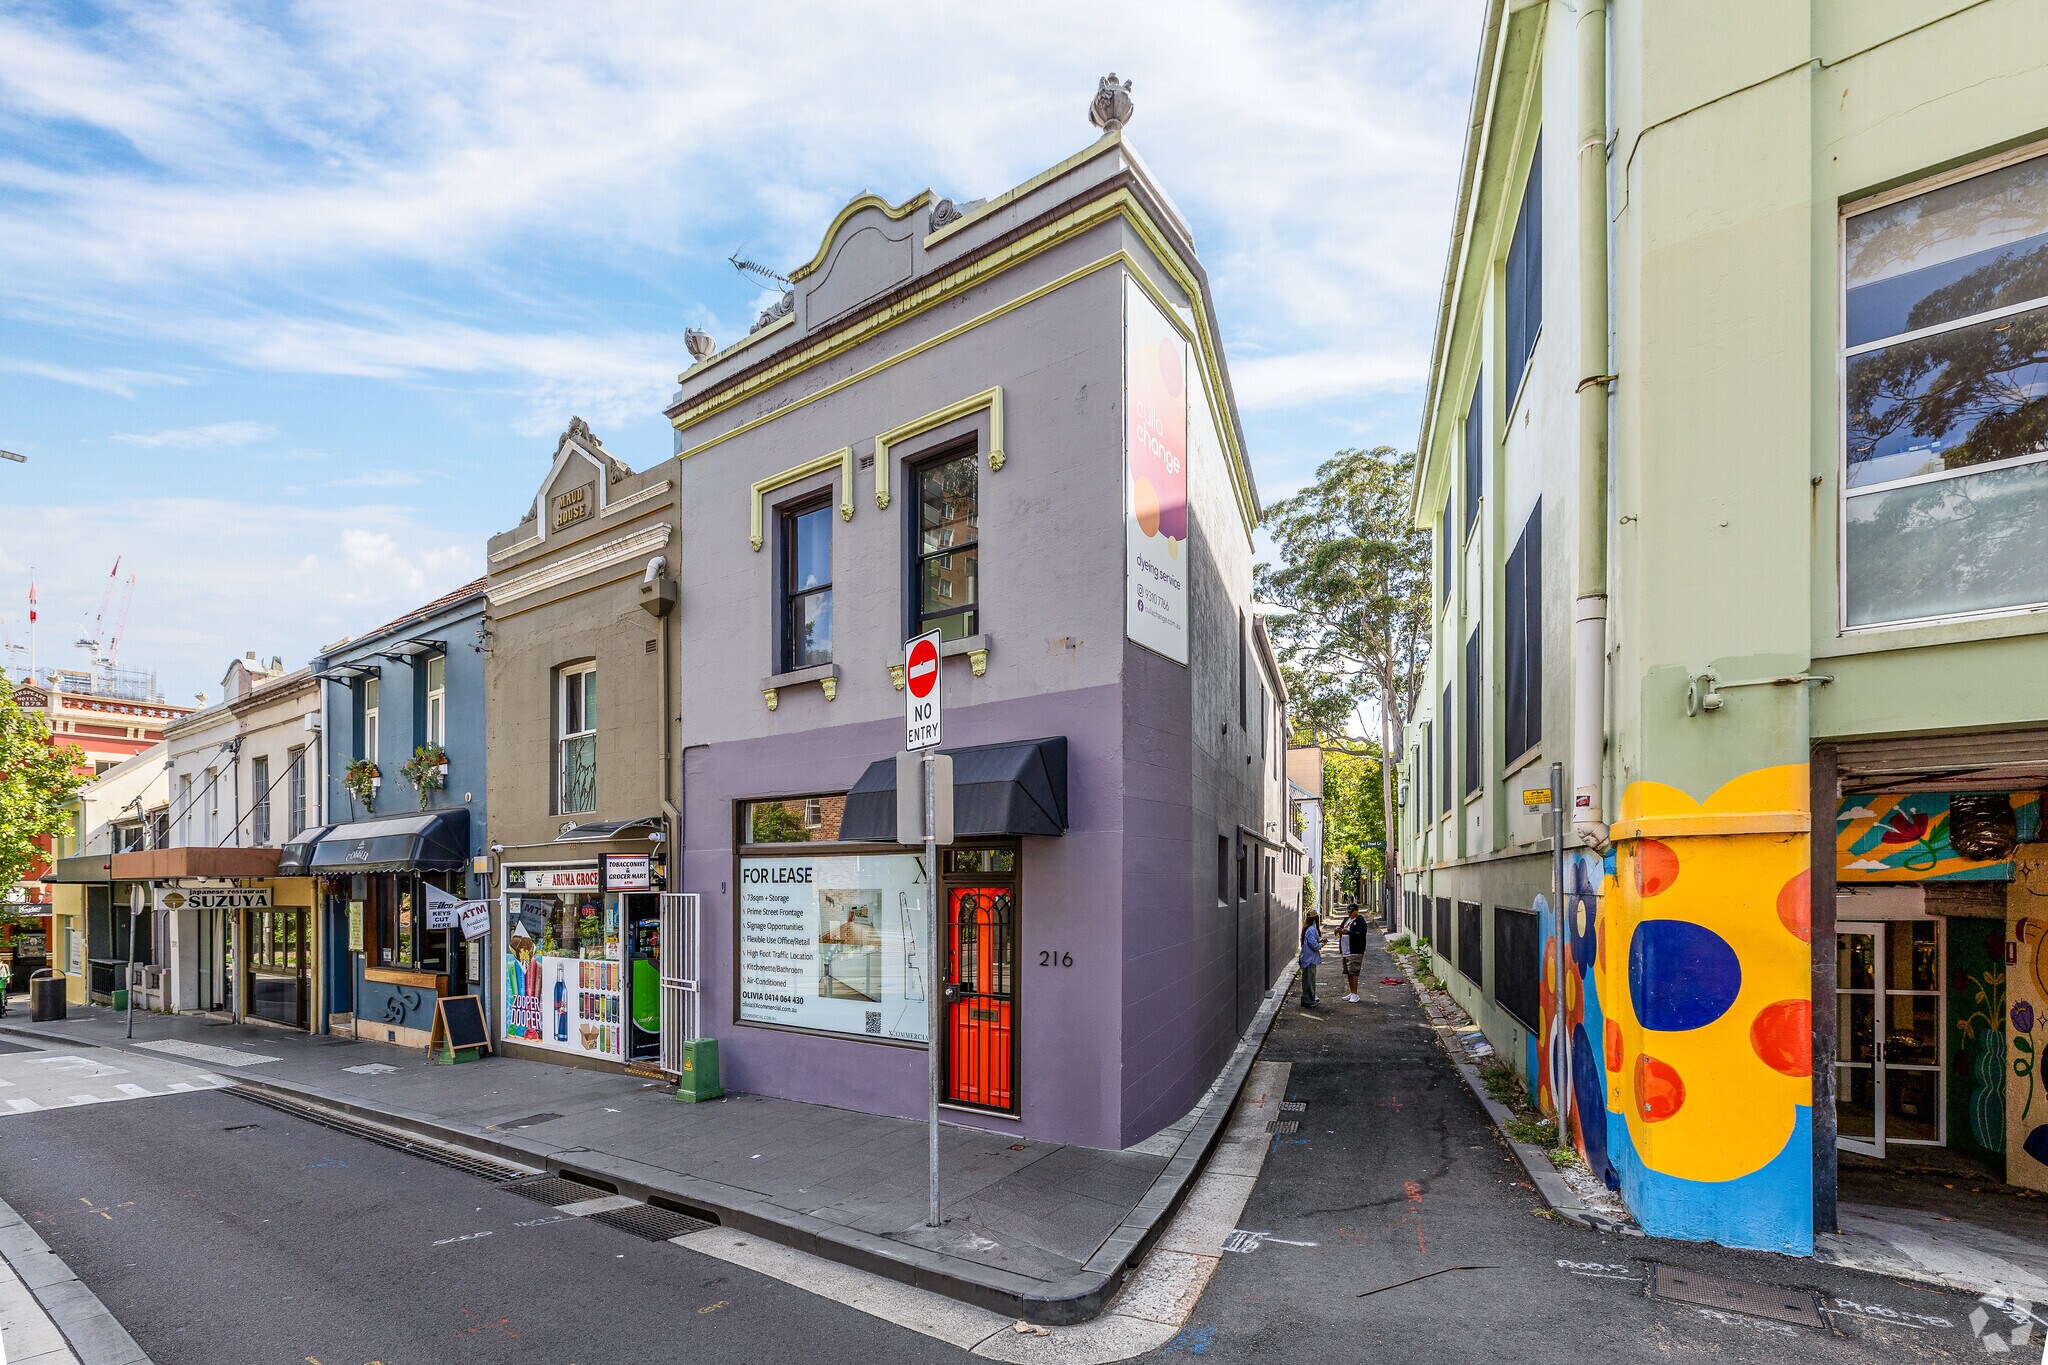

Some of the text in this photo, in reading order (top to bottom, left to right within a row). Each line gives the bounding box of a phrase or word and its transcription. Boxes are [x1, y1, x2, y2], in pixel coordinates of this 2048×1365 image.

[1137, 424, 1180, 473] change
[559, 488, 583, 509] MAUD
[557, 504, 586, 526] HOUSE
[1137, 553, 1180, 590] dyeing service
[915, 703, 932, 722] NO
[909, 723, 938, 742] ENTRY
[552, 872, 599, 886] ARUMA GROCE
[743, 867, 813, 883] FOR LEASE
[188, 895, 267, 908] SUZUYA
[747, 894, 764, 903] 73sqm
[769, 894, 789, 904] Storage
[462, 905, 486, 920] ATM
[763, 908, 778, 916] Street
[780, 909, 803, 918] Frontage
[747, 922, 804, 931] Signage Opportunities
[747, 936, 810, 946] Flexible Use Office/Retail
[747, 949, 814, 960] High Foot Traffic Location
[1039, 951, 1073, 967] 216
[747, 963, 804, 974] Kitchenette/Bathroom
[747, 977, 787, 987] Air-Conditioned
[513, 994, 541, 1010] ZOOPER
[742, 991, 804, 1005] OLIVIA 0414 064 430
[511, 1008, 542, 1030] DOOPER
[888, 1030, 929, 1040] XCOMMERCIA
